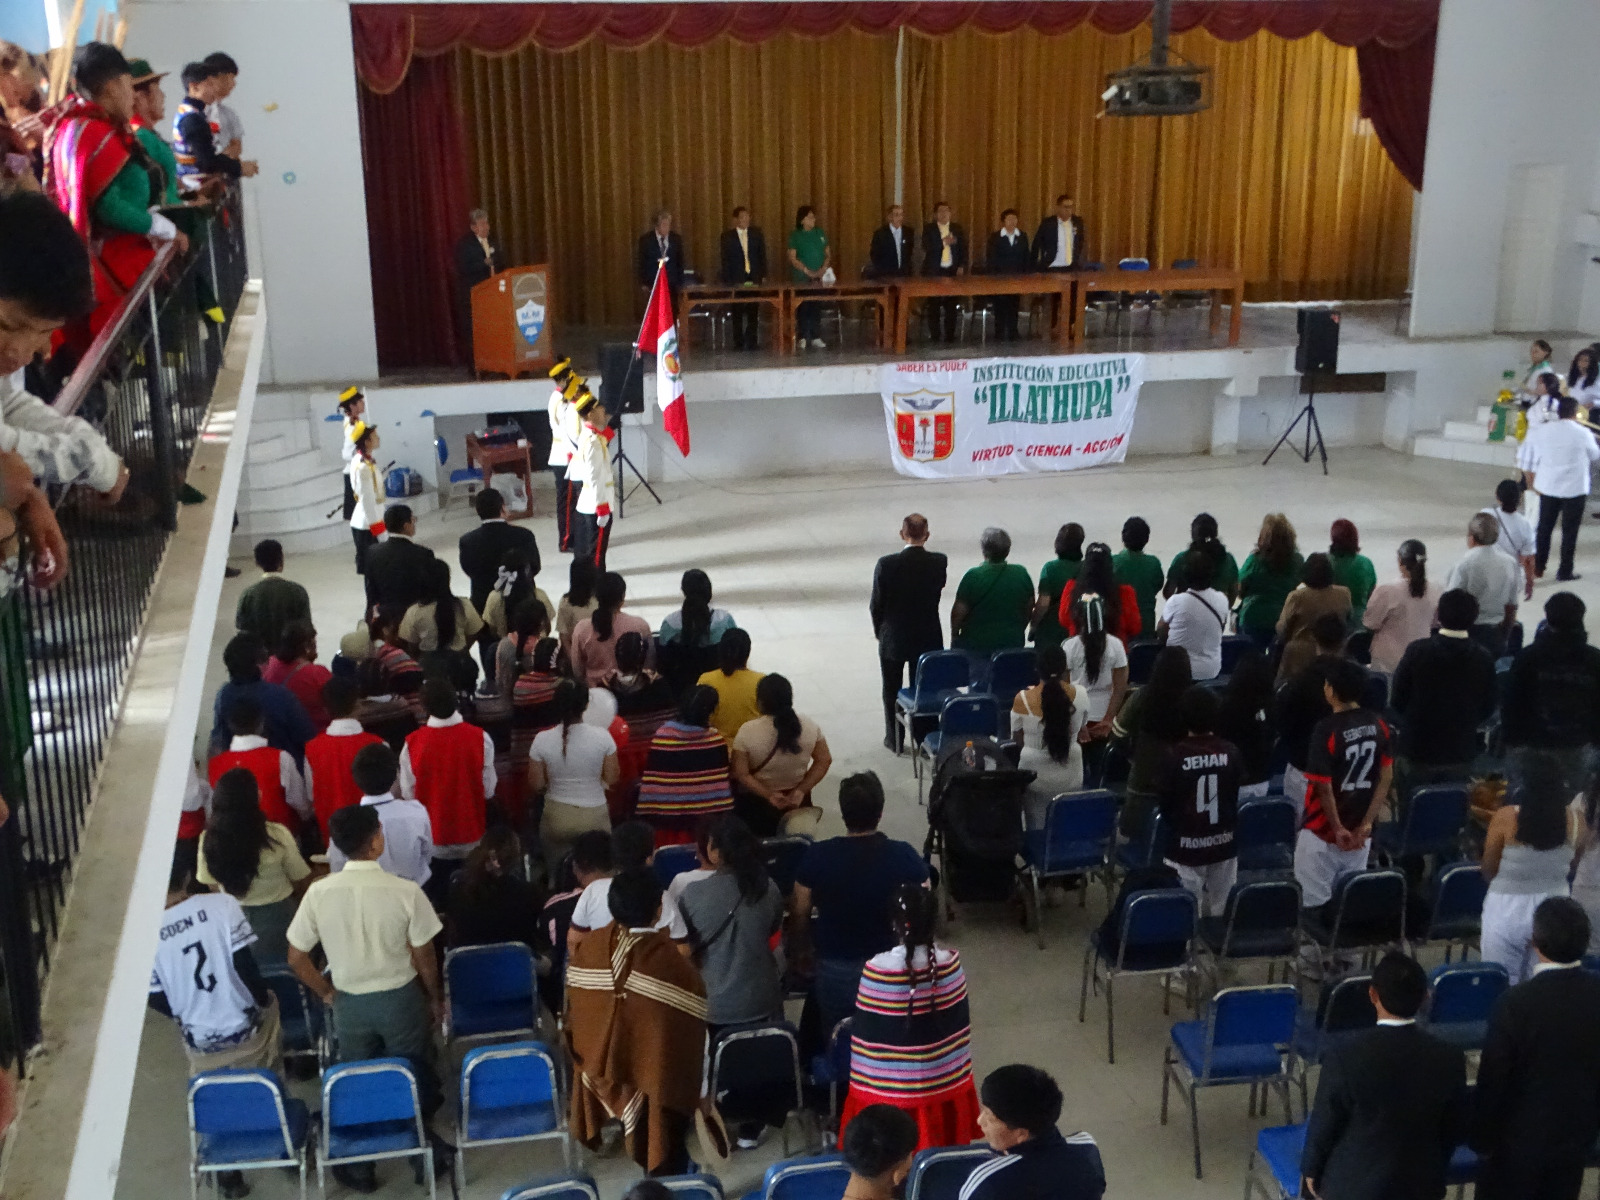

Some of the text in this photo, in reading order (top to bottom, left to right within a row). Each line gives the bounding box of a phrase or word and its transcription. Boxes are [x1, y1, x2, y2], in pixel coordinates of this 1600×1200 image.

[896, 362, 924, 373] SABER
[926, 362, 937, 373] ES
[972, 358, 1126, 383] INSTITUCIÓN EDUCATIVA
[971, 445, 1014, 462] VIRTUD
[1026, 445, 1072, 457] CIENCIA
[1182, 753, 1228, 771] JEHAN
[1341, 741, 1377, 792] 22
[1196, 774, 1219, 824] 4
[1180, 831, 1233, 849] PROMOCIÓN
[182, 940, 218, 992] 2
